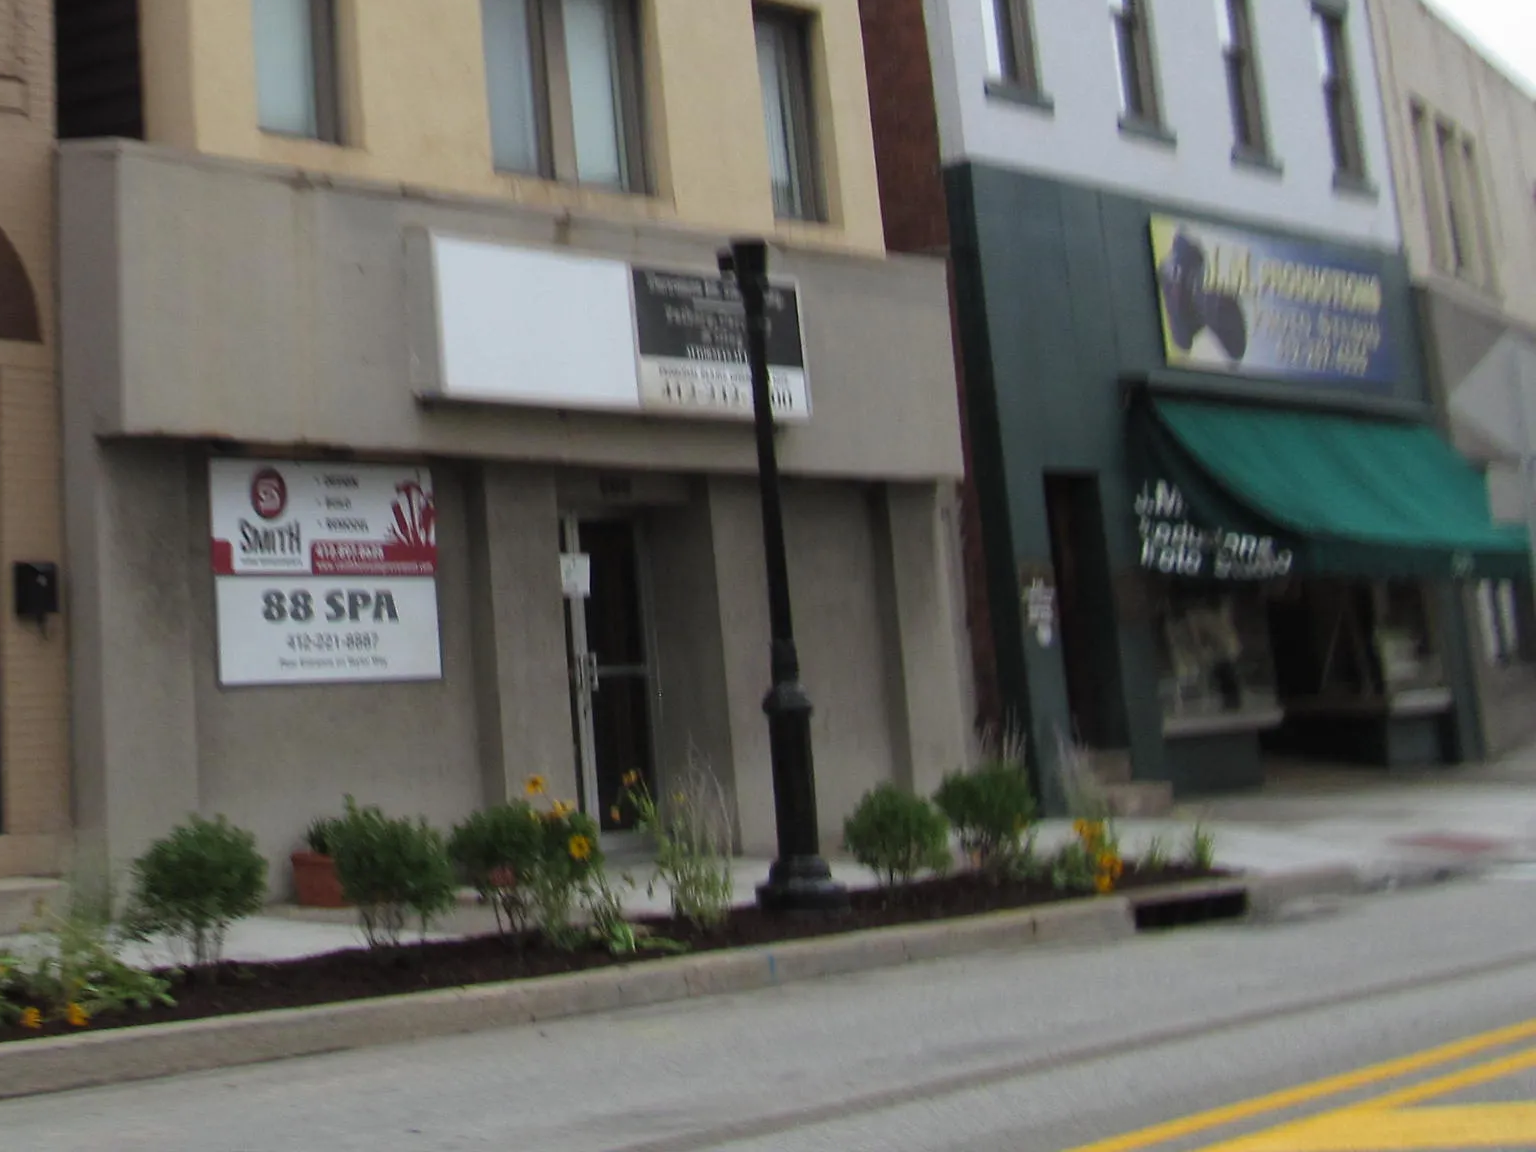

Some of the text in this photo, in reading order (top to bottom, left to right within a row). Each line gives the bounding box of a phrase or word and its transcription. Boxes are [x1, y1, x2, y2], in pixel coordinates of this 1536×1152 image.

[239, 518, 302, 557] SMITH
[261, 588, 400, 624] 88 SPA
